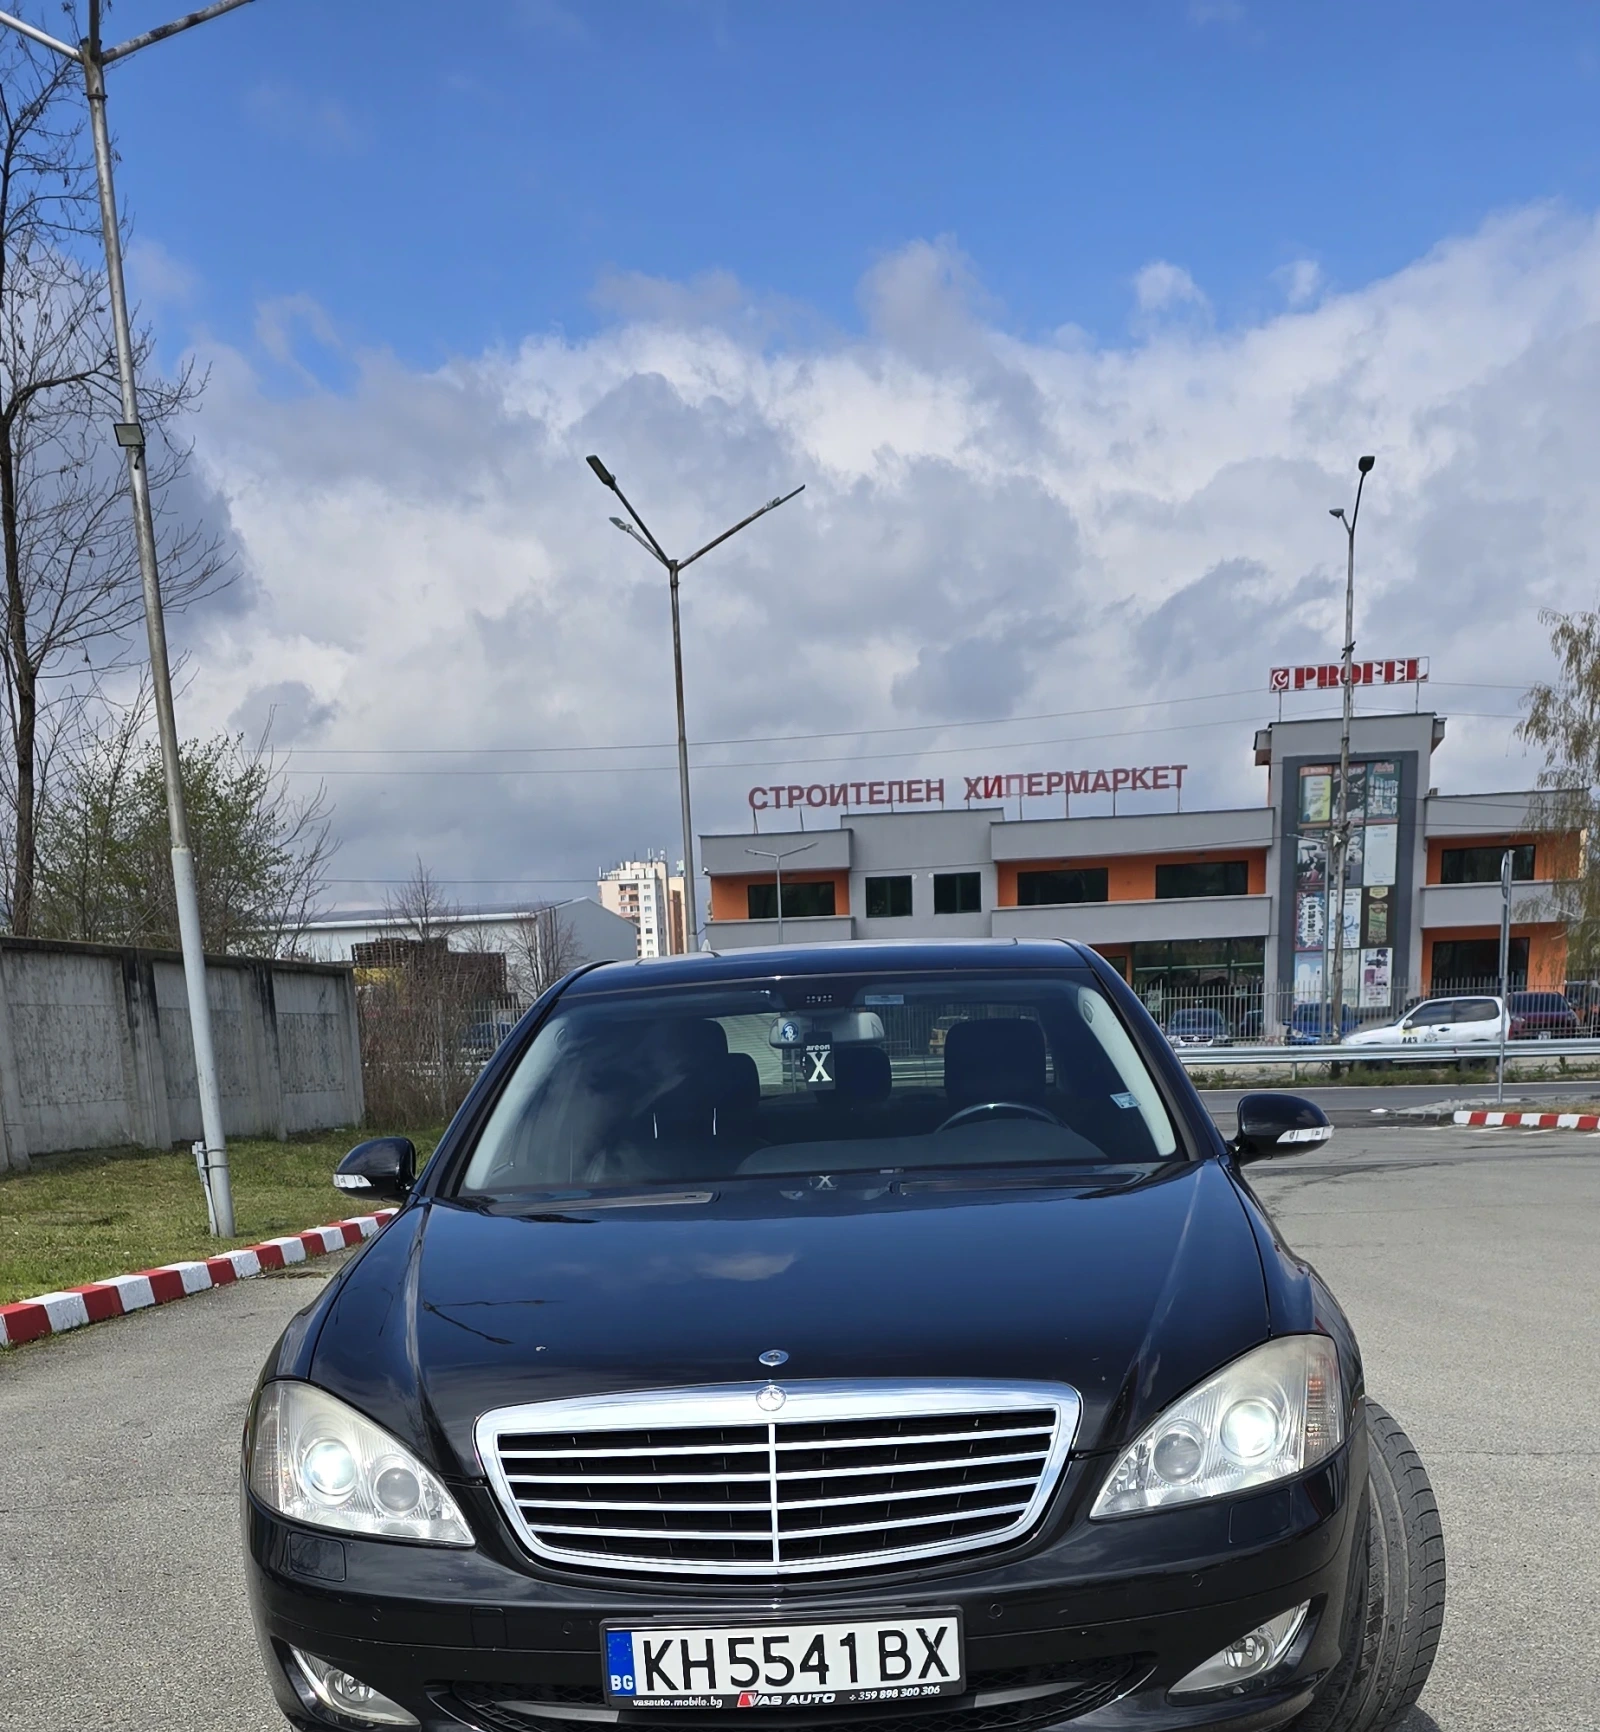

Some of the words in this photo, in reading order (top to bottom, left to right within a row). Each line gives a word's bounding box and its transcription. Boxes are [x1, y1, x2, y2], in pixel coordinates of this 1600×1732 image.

[1294, 658, 1429, 689] PROFEL
[748, 778, 945, 810] СТРОИТЕЛЕН
[963, 764, 1188, 801] ХИПЕРМАРКЕТ
[807, 1051, 833, 1082] X
[610, 1674, 634, 1691] BG
[748, 1694, 783, 1707] VAS
[786, 1692, 836, 1705] AUTO
[879, 1688, 898, 1699] 898
[900, 1686, 920, 1697] 300
[921, 1685, 941, 1695] 306
[633, 1696, 723, 1708] vasauto.mobile.bg
